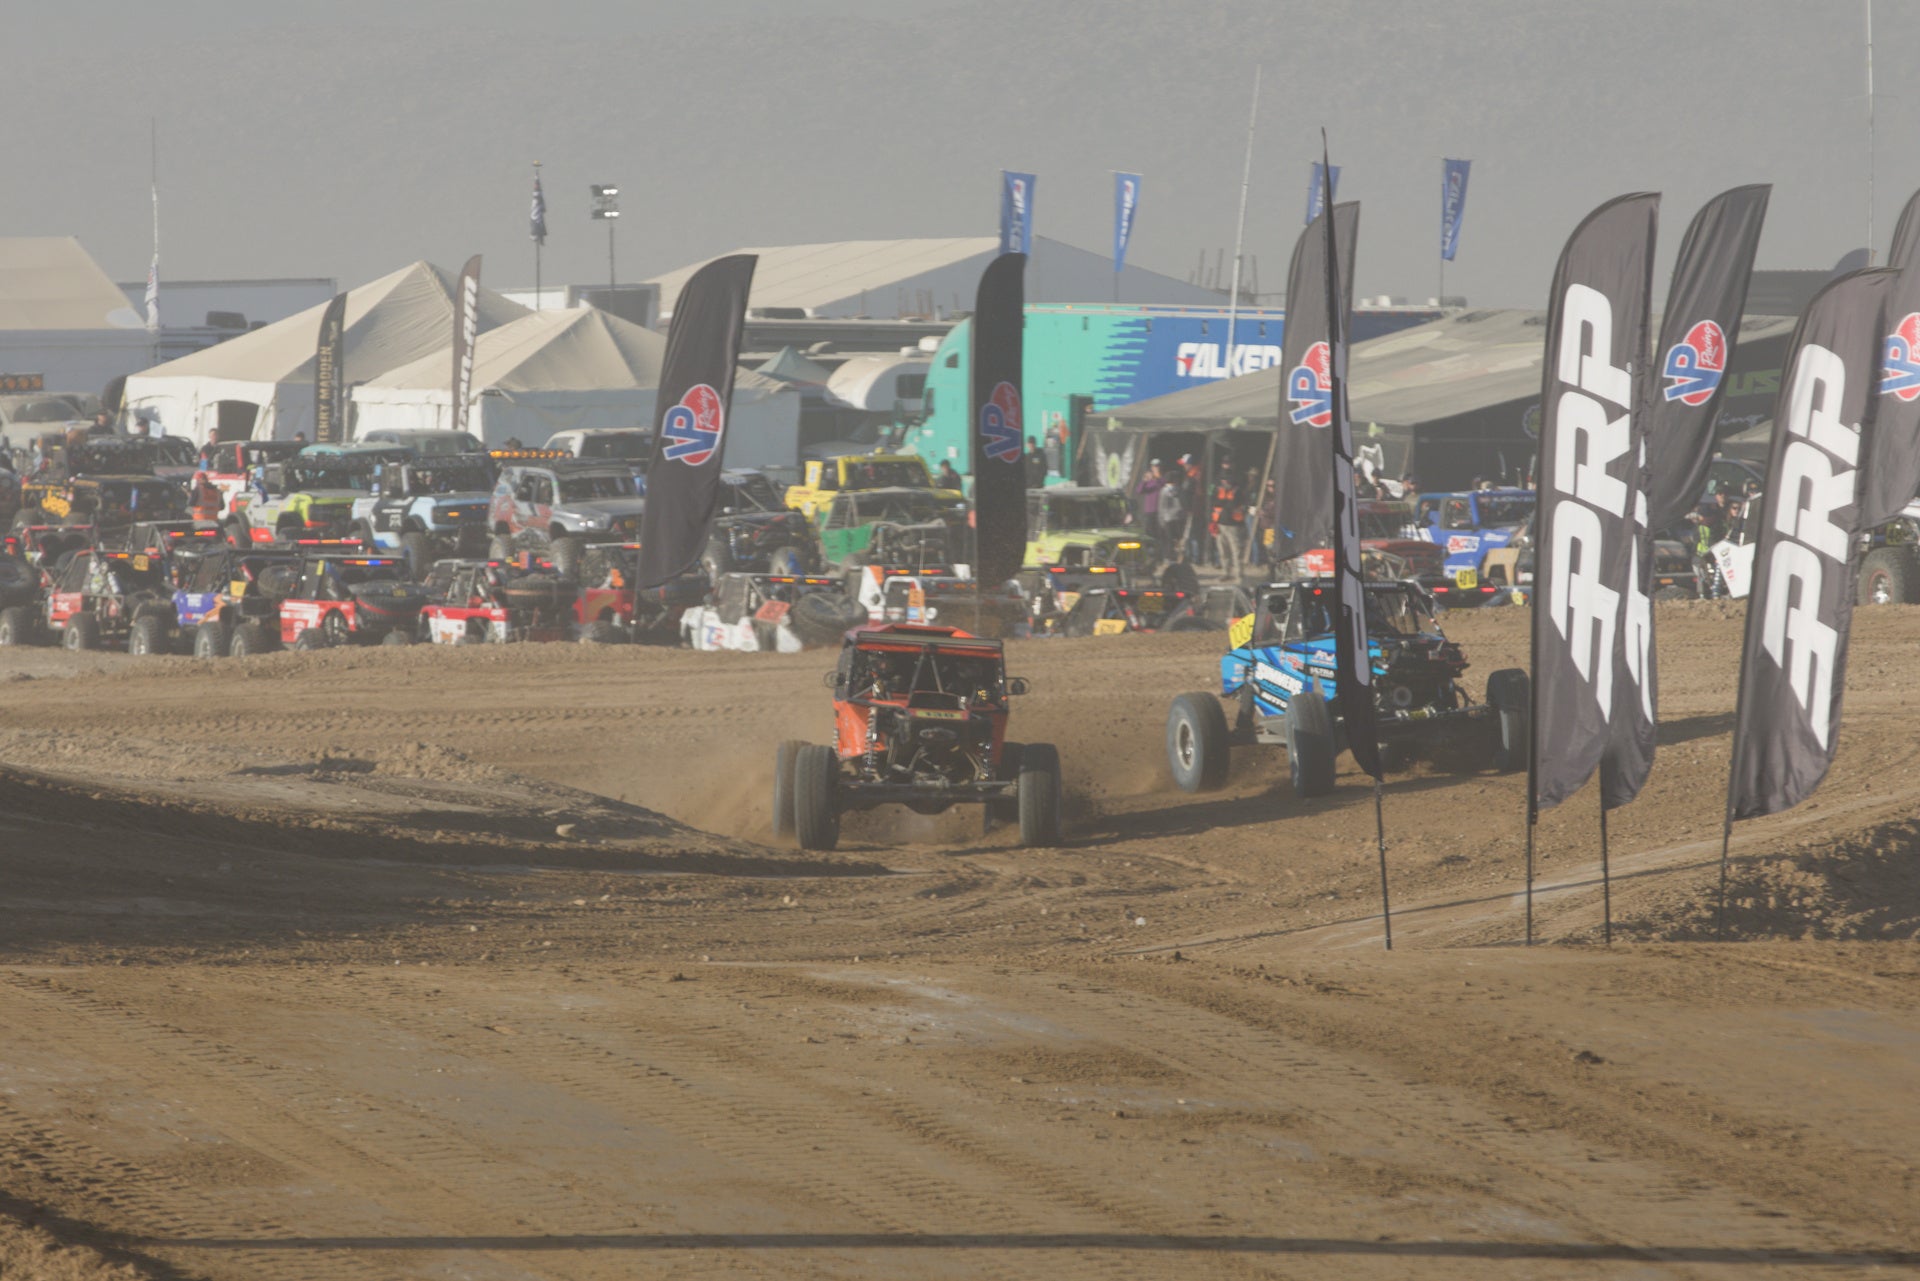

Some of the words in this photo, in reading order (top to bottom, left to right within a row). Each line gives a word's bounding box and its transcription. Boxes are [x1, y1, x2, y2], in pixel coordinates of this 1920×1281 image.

[319, 346, 332, 400] MADDEN
[1663, 343, 1722, 402] VP
[662, 405, 720, 461] VP
[981, 402, 1021, 459] VP
[1550, 283, 1632, 725] PRP
[1762, 343, 1861, 751] PRP
